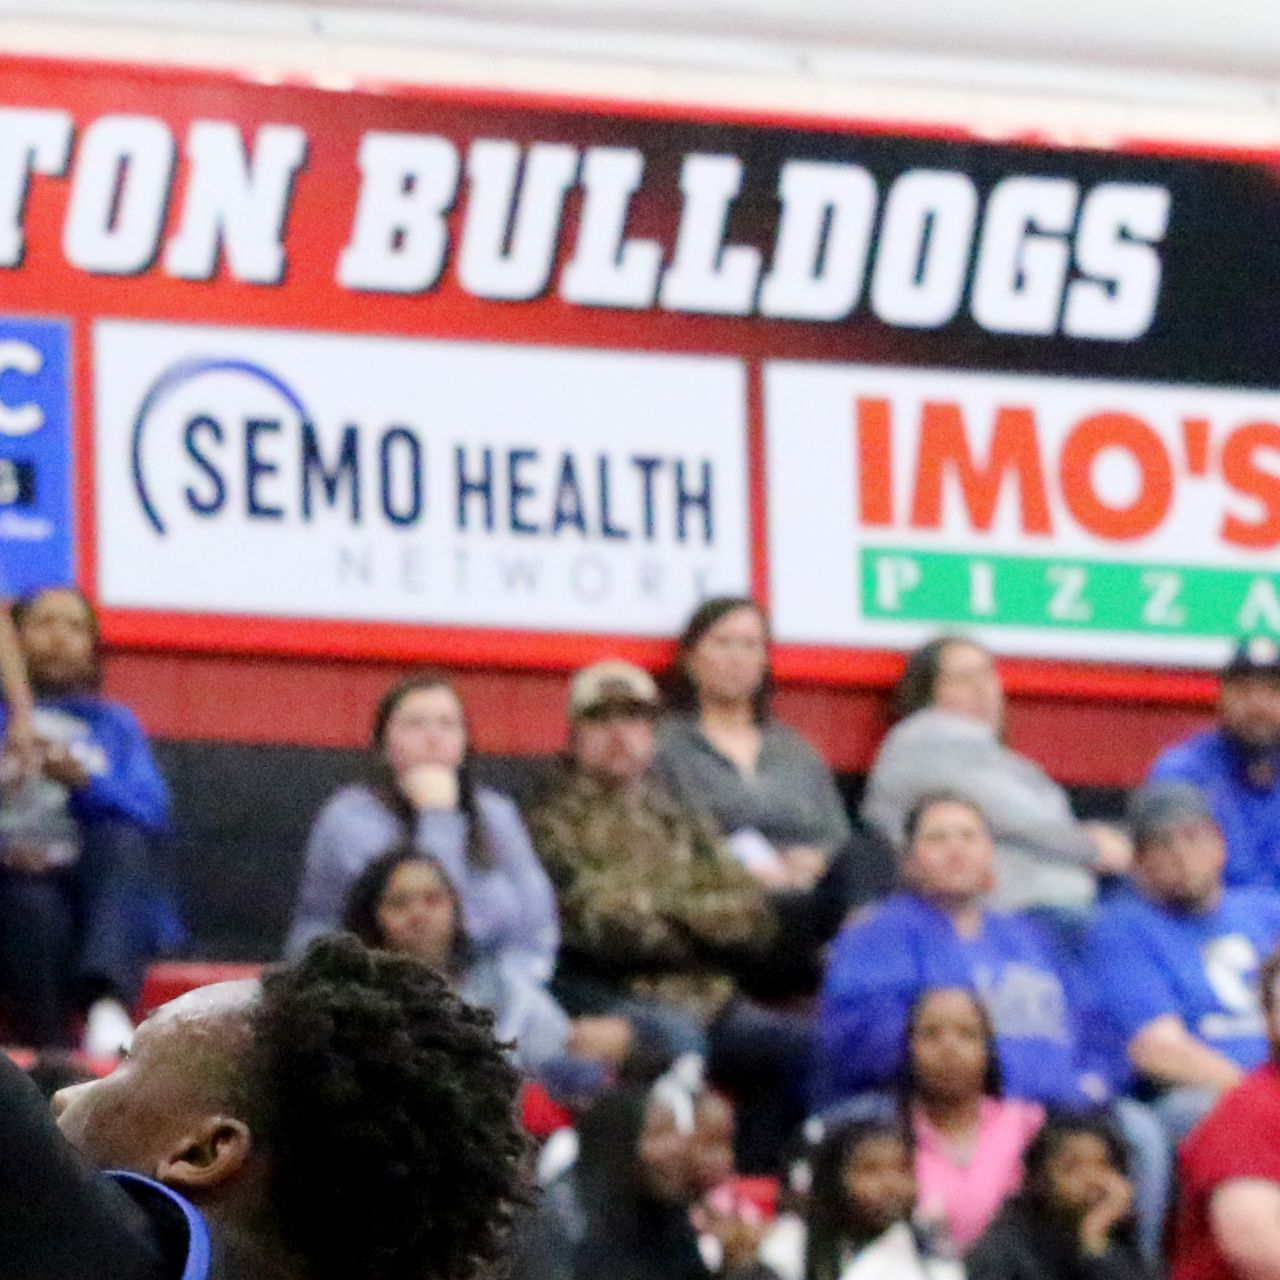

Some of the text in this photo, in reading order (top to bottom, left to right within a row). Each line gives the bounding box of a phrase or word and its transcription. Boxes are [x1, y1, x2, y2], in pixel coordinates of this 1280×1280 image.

[336, 132, 1172, 342] BULLDOGS
[182, 414, 716, 546] SEMO HEALTH
[854, 396, 1280, 552] IMO'S
[874, 556, 1280, 633] PIZZA
